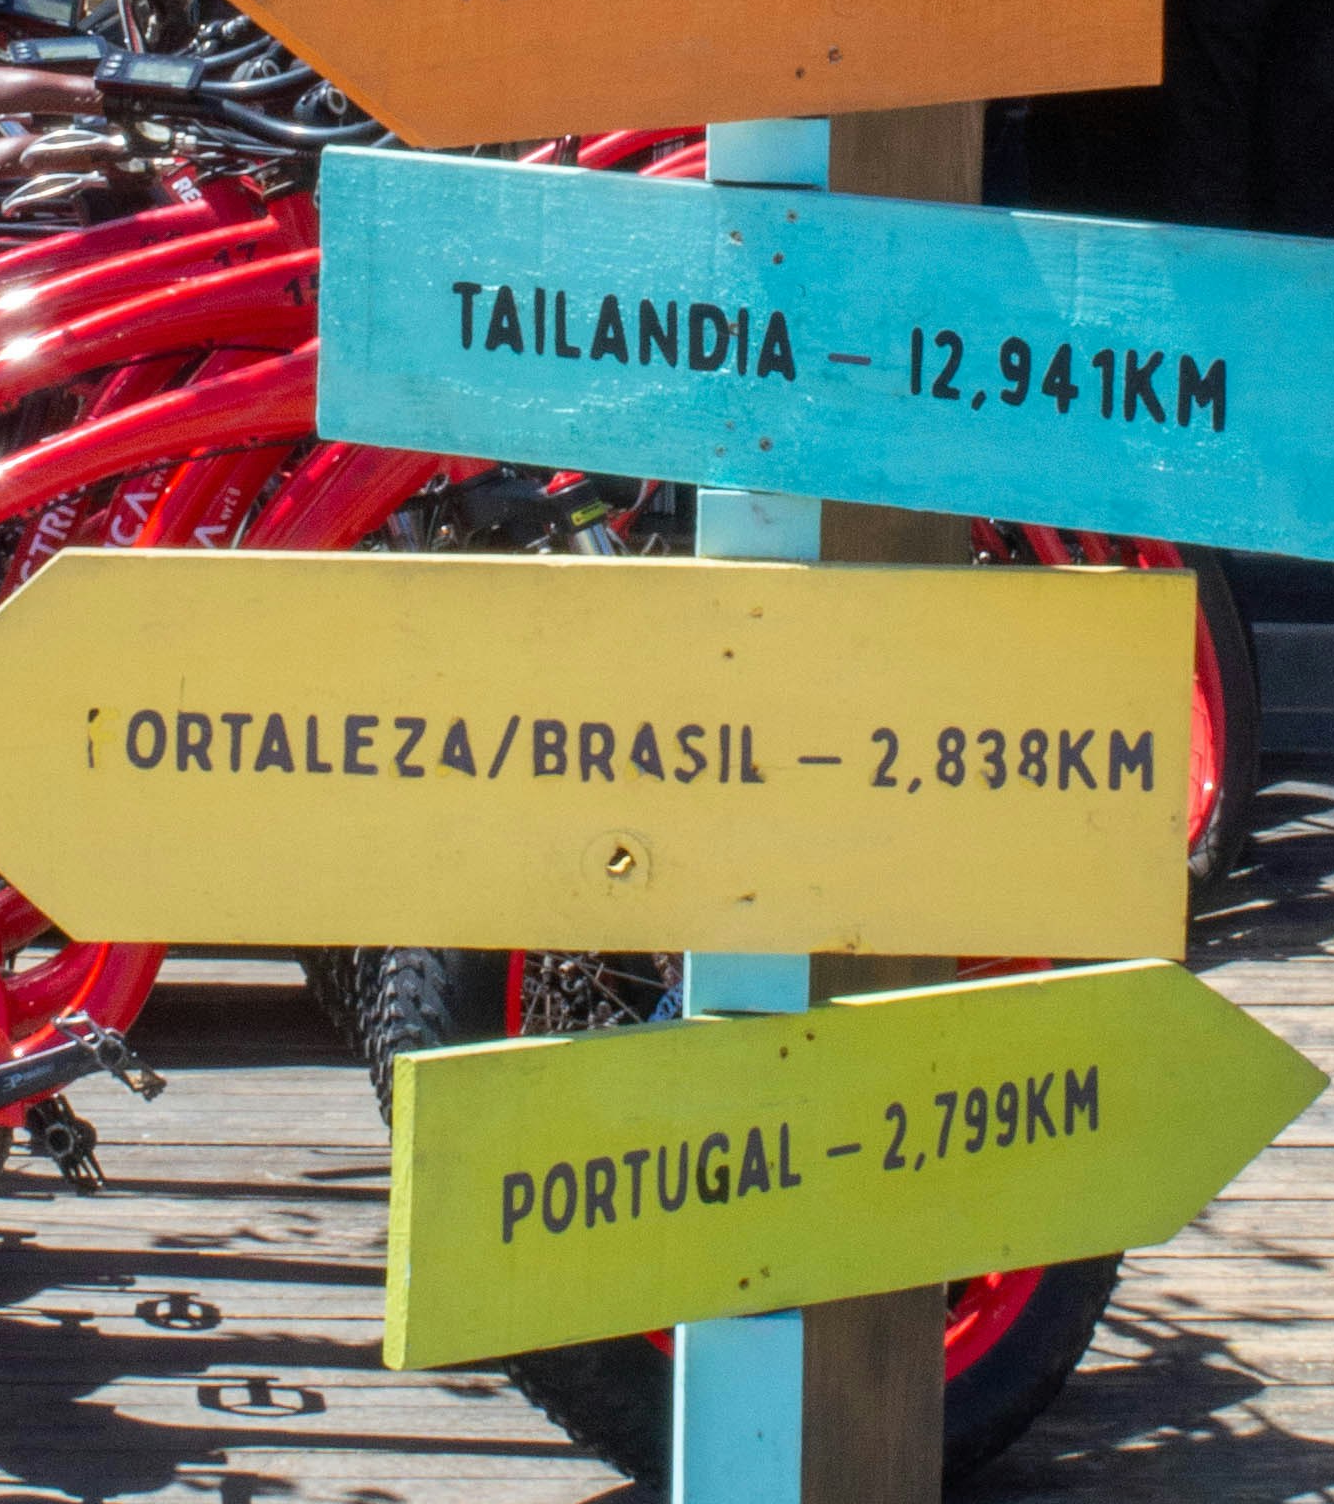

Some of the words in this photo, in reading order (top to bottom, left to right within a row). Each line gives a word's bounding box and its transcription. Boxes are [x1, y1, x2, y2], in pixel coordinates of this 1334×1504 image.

[451, 280, 797, 383] TAILANDIA
[909, 326, 1228, 434] 12,941KM
[870, 726, 1155, 793] 2,838KM
[501, 1121, 803, 1245] PORTUGAL
[882, 1064, 1100, 1174] 2,799KM
